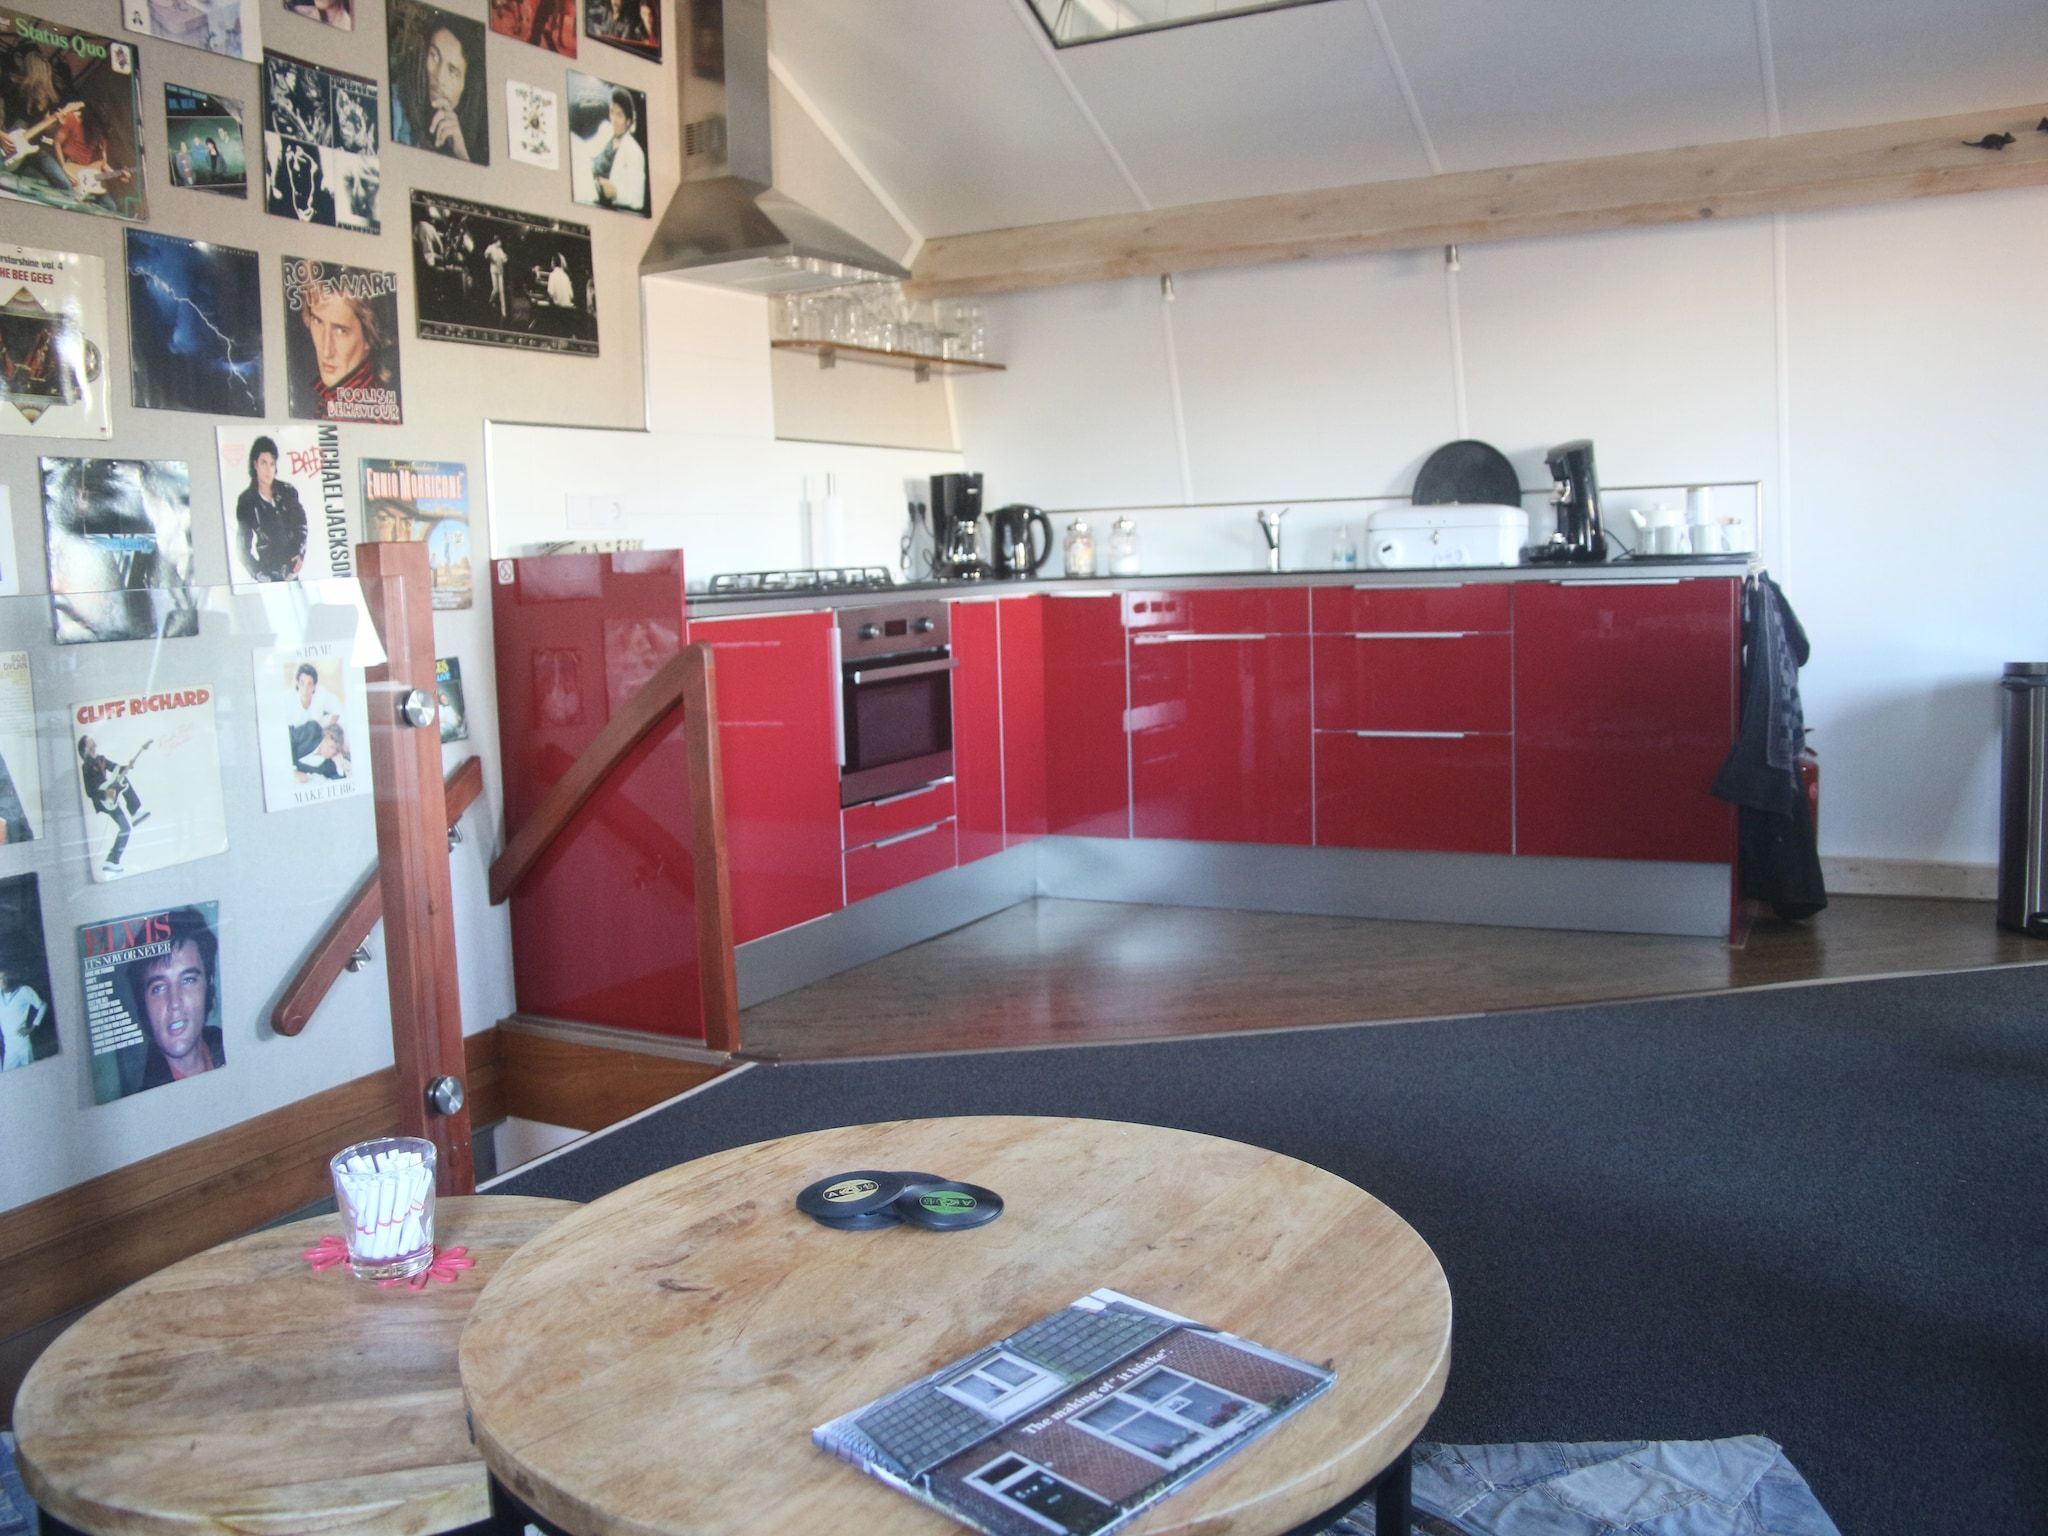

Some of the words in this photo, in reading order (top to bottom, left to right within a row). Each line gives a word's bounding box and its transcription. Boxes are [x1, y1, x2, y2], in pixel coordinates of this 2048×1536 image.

[15, 17, 69, 49] Status
[72, 35, 107, 58] Quo
[0, 255, 39, 268] rstarshine
[41, 261, 56, 270] vol.
[57, 262, 63, 270] 4
[0, 267, 11, 279] HE
[12, 269, 29, 282] BEE
[30, 271, 54, 285] GEES
[283, 260, 325, 286] ROD
[286, 271, 397, 311] STEWART
[327, 401, 400, 421] BEHAVIOUR
[336, 387, 397, 405] FOOLISH
[318, 424, 344, 503] MICHAEL
[366, 467, 399, 502] ENNIO
[399, 468, 464, 503] MORRICONE
[76, 700, 126, 725] CLIFF
[129, 688, 210, 716] RICHARD
[294, 788, 323, 803] MAKE
[84, 913, 172, 959] ELVIS
[102, 953, 122, 967] NOW
[123, 948, 136, 961] OR
[137, 942, 171, 958] NEVER
[1020, 1416, 1053, 1435] The
[1051, 1389, 1104, 1420] making
